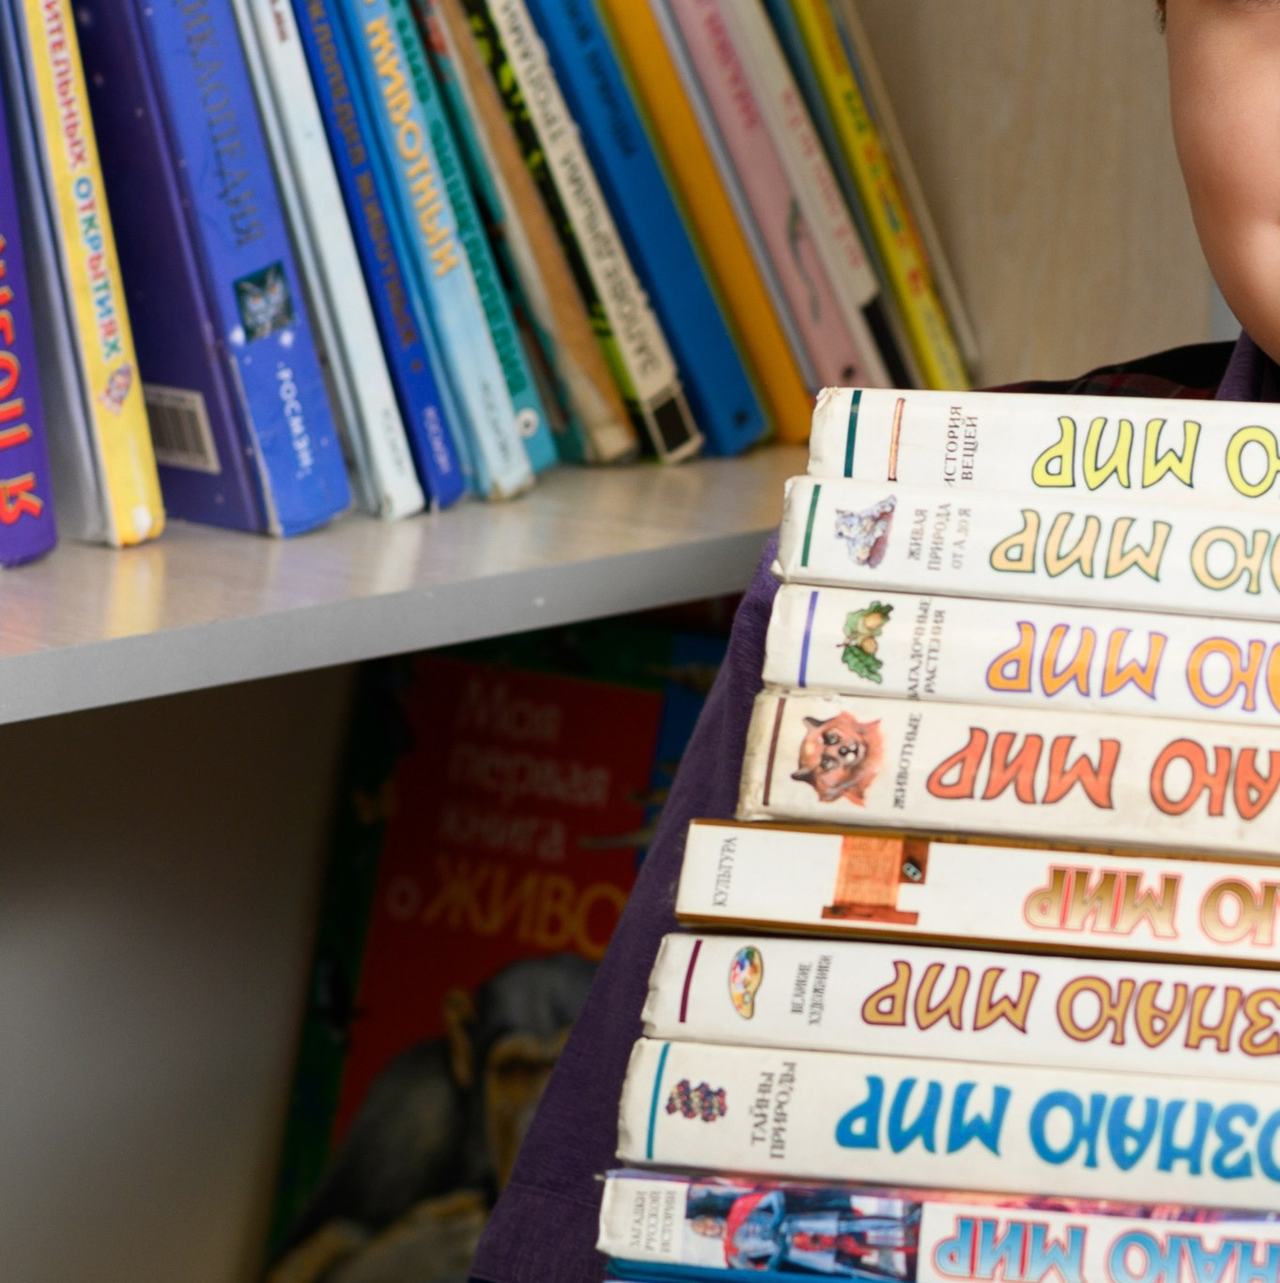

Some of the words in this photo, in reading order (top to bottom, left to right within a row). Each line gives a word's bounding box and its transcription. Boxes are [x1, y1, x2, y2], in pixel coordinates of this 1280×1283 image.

[71, 175, 125, 362] ОТКРЫТИЯХ
[960, 415, 979, 481] ВЕЩЕЙ
[1032, 416, 1201, 490] МИР
[907, 508, 929, 561] ЖИВАЯ
[927, 502, 952, 571] ПРИРОДА
[989, 509, 1173, 583] МИР
[926, 608, 946, 694] РАСТЕНИЯ
[985, 620, 1168, 700] МИР
[893, 711, 922, 809] ЖИВОТНЫЕ
[926, 726, 1122, 810] МИР
[712, 836, 738, 908] КУЛЬТУРА
[1022, 863, 1183, 939] МИР
[861, 960, 1040, 1035] МИР
[750, 1070, 775, 1148] ТАЙНЫ
[769, 1059, 797, 1161] ПРИРОДЫ
[835, 1074, 1012, 1156] МИР
[630, 1189, 647, 1250] ЗАГАДКИ
[644, 1190, 661, 1252] РУССКОЙ
[660, 1189, 677, 1253] ИСТОРИИ
